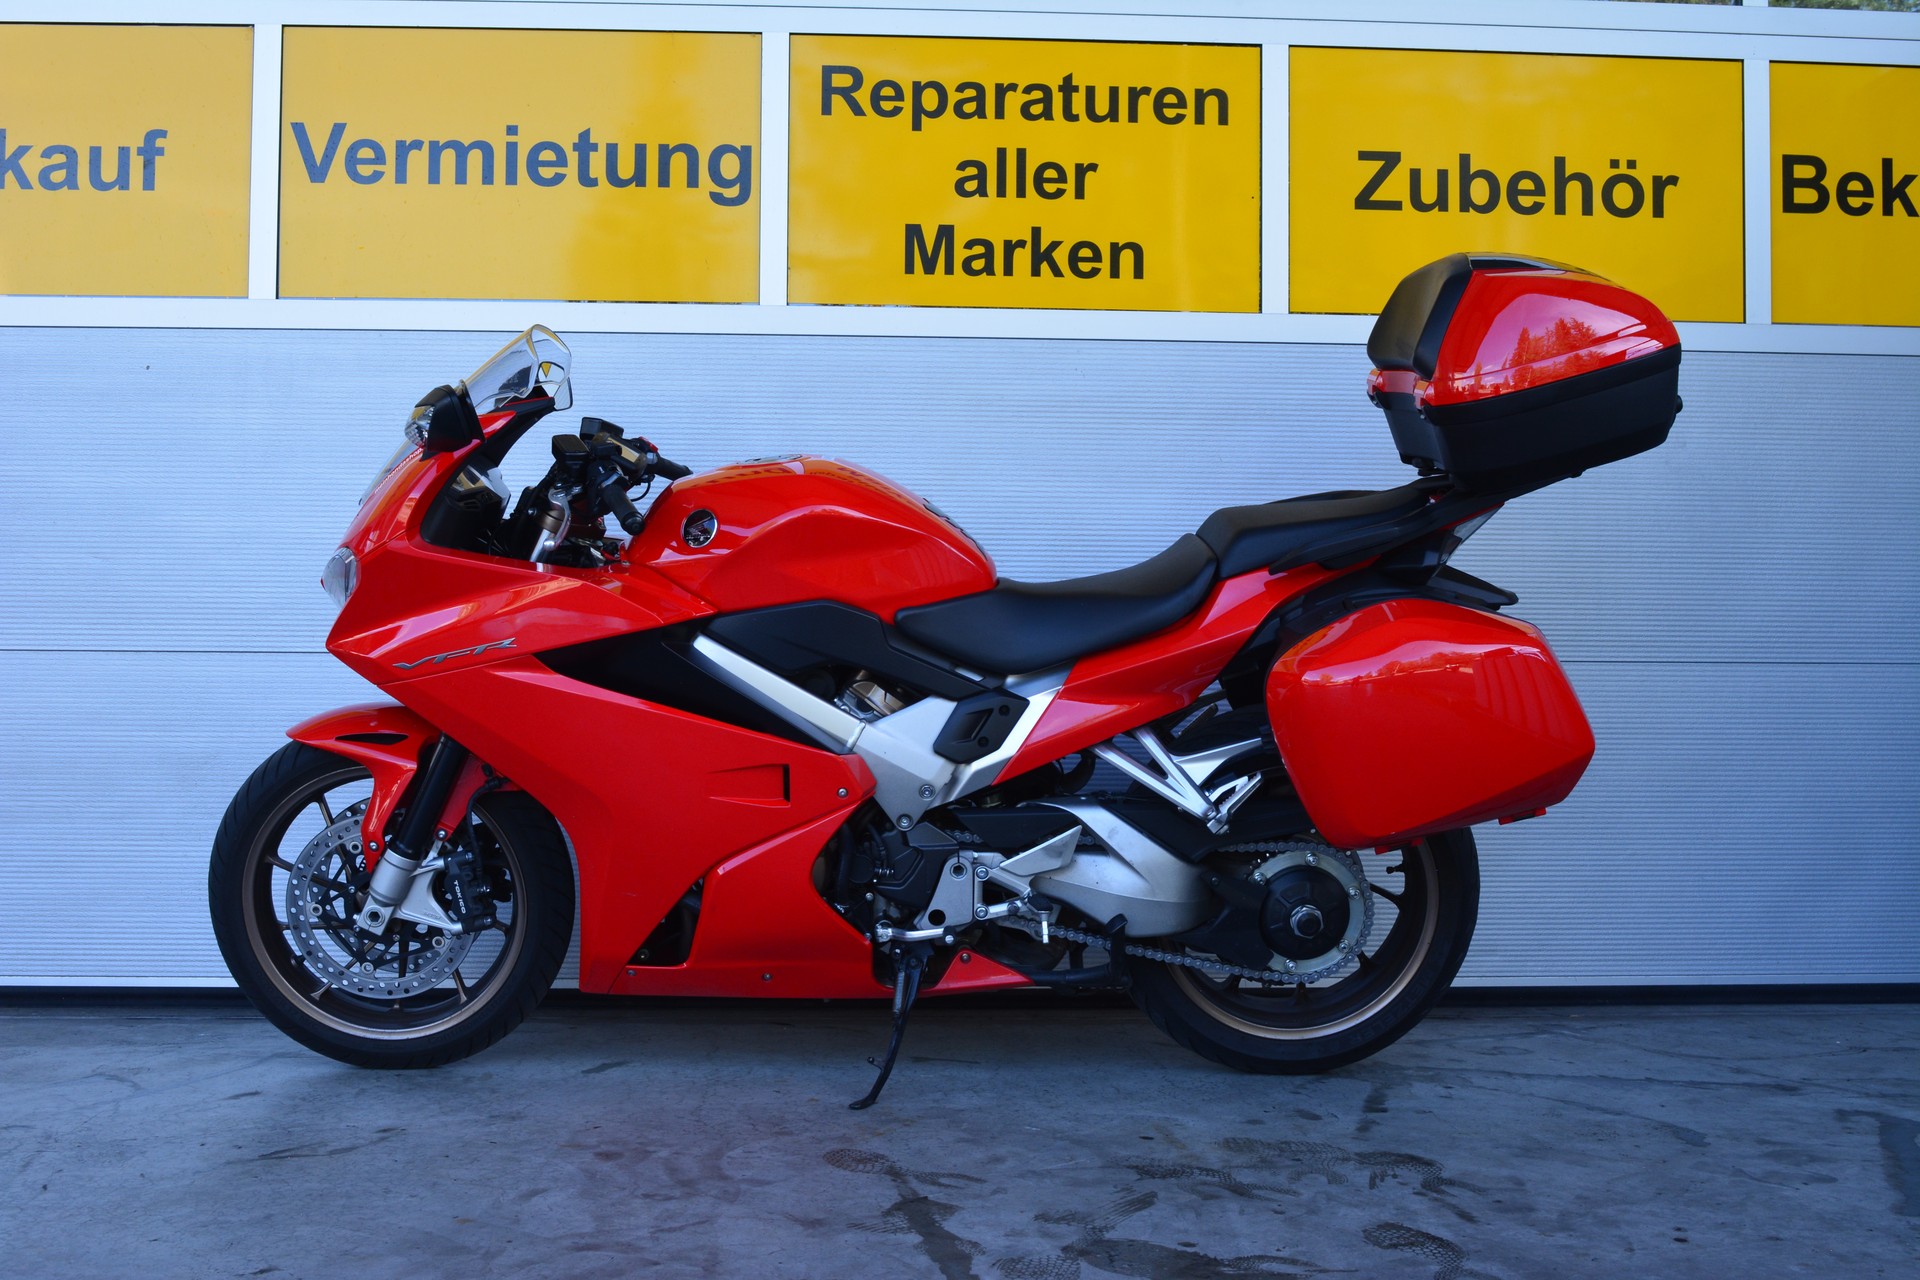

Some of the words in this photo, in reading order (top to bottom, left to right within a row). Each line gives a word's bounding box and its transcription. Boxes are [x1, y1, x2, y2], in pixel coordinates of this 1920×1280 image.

[821, 64, 1229, 132] Reparaturen
[0, 128, 168, 192] kauf
[290, 122, 753, 207] Vermietung
[954, 147, 1099, 200] aller
[1354, 150, 1680, 219] Zubehör
[1781, 153, 1920, 218] Bek
[904, 223, 1144, 280] Marken
[453, 880, 466, 914] TOKICO
